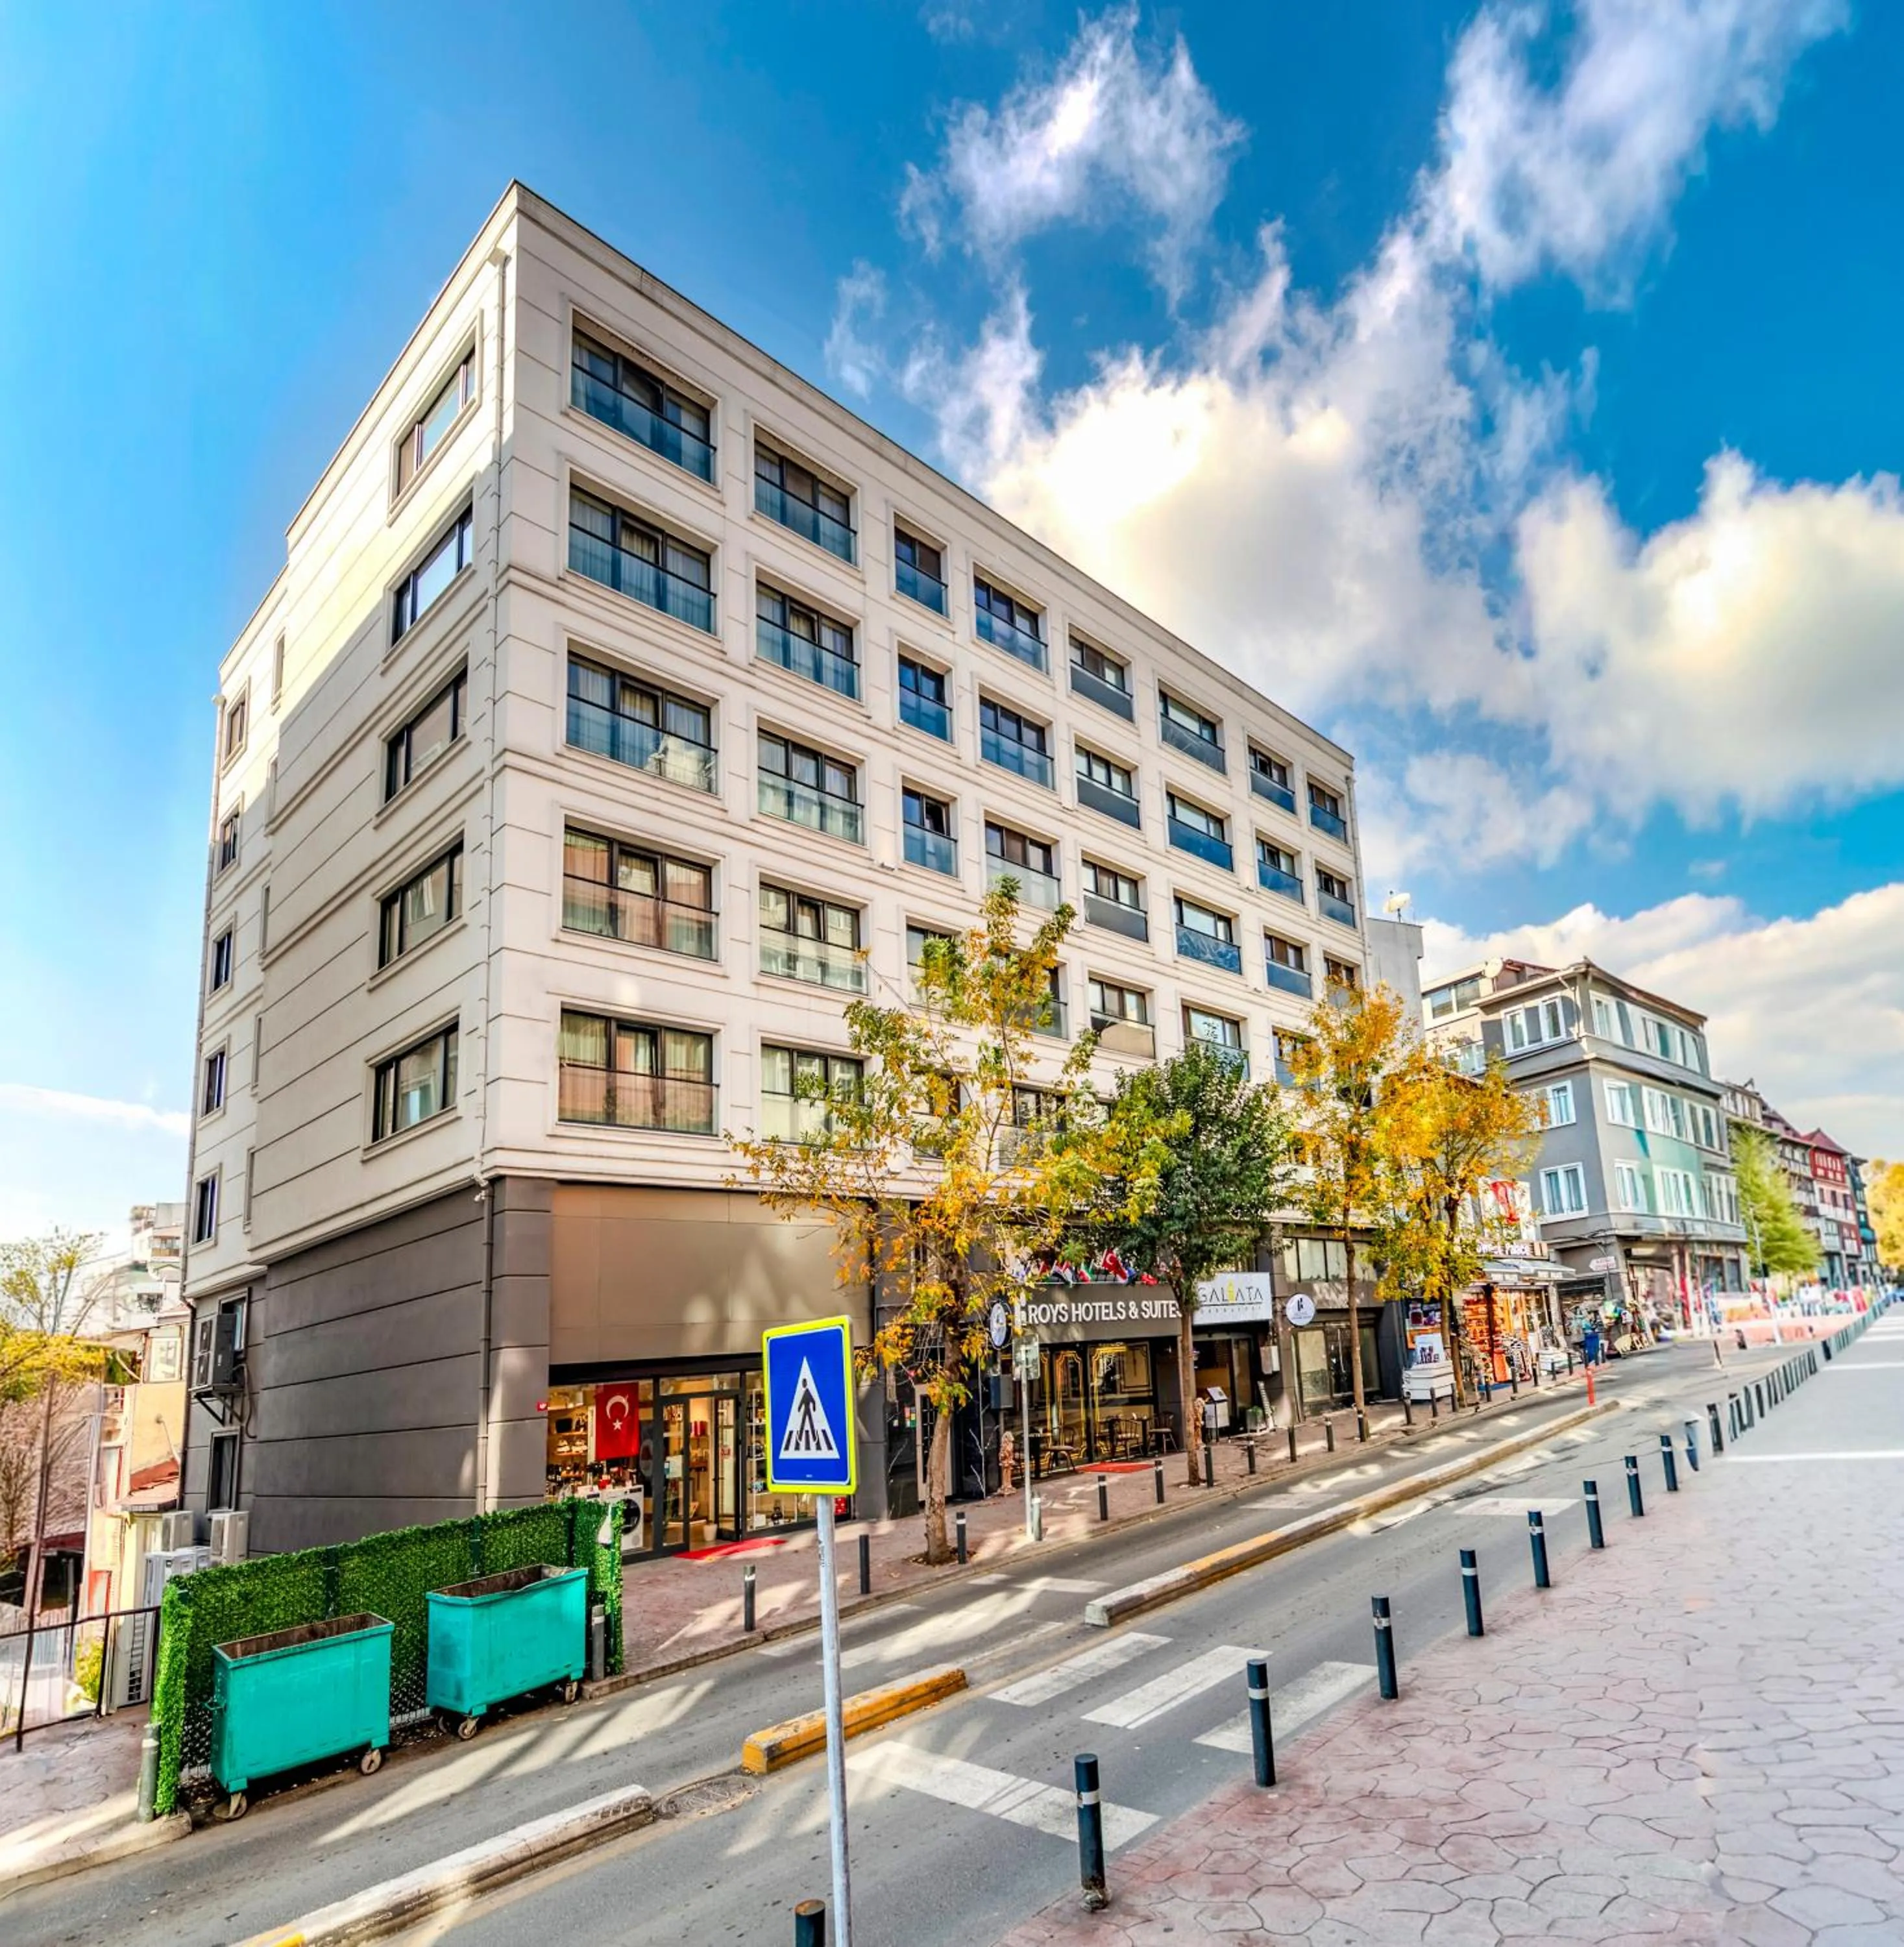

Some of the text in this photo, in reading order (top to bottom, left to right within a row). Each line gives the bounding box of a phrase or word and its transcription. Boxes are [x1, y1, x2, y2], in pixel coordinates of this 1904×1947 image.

[1027, 1303, 1069, 1325] ROYS
[1071, 1301, 1126, 1322] HOTELS
[1129, 1300, 1140, 1319] &
